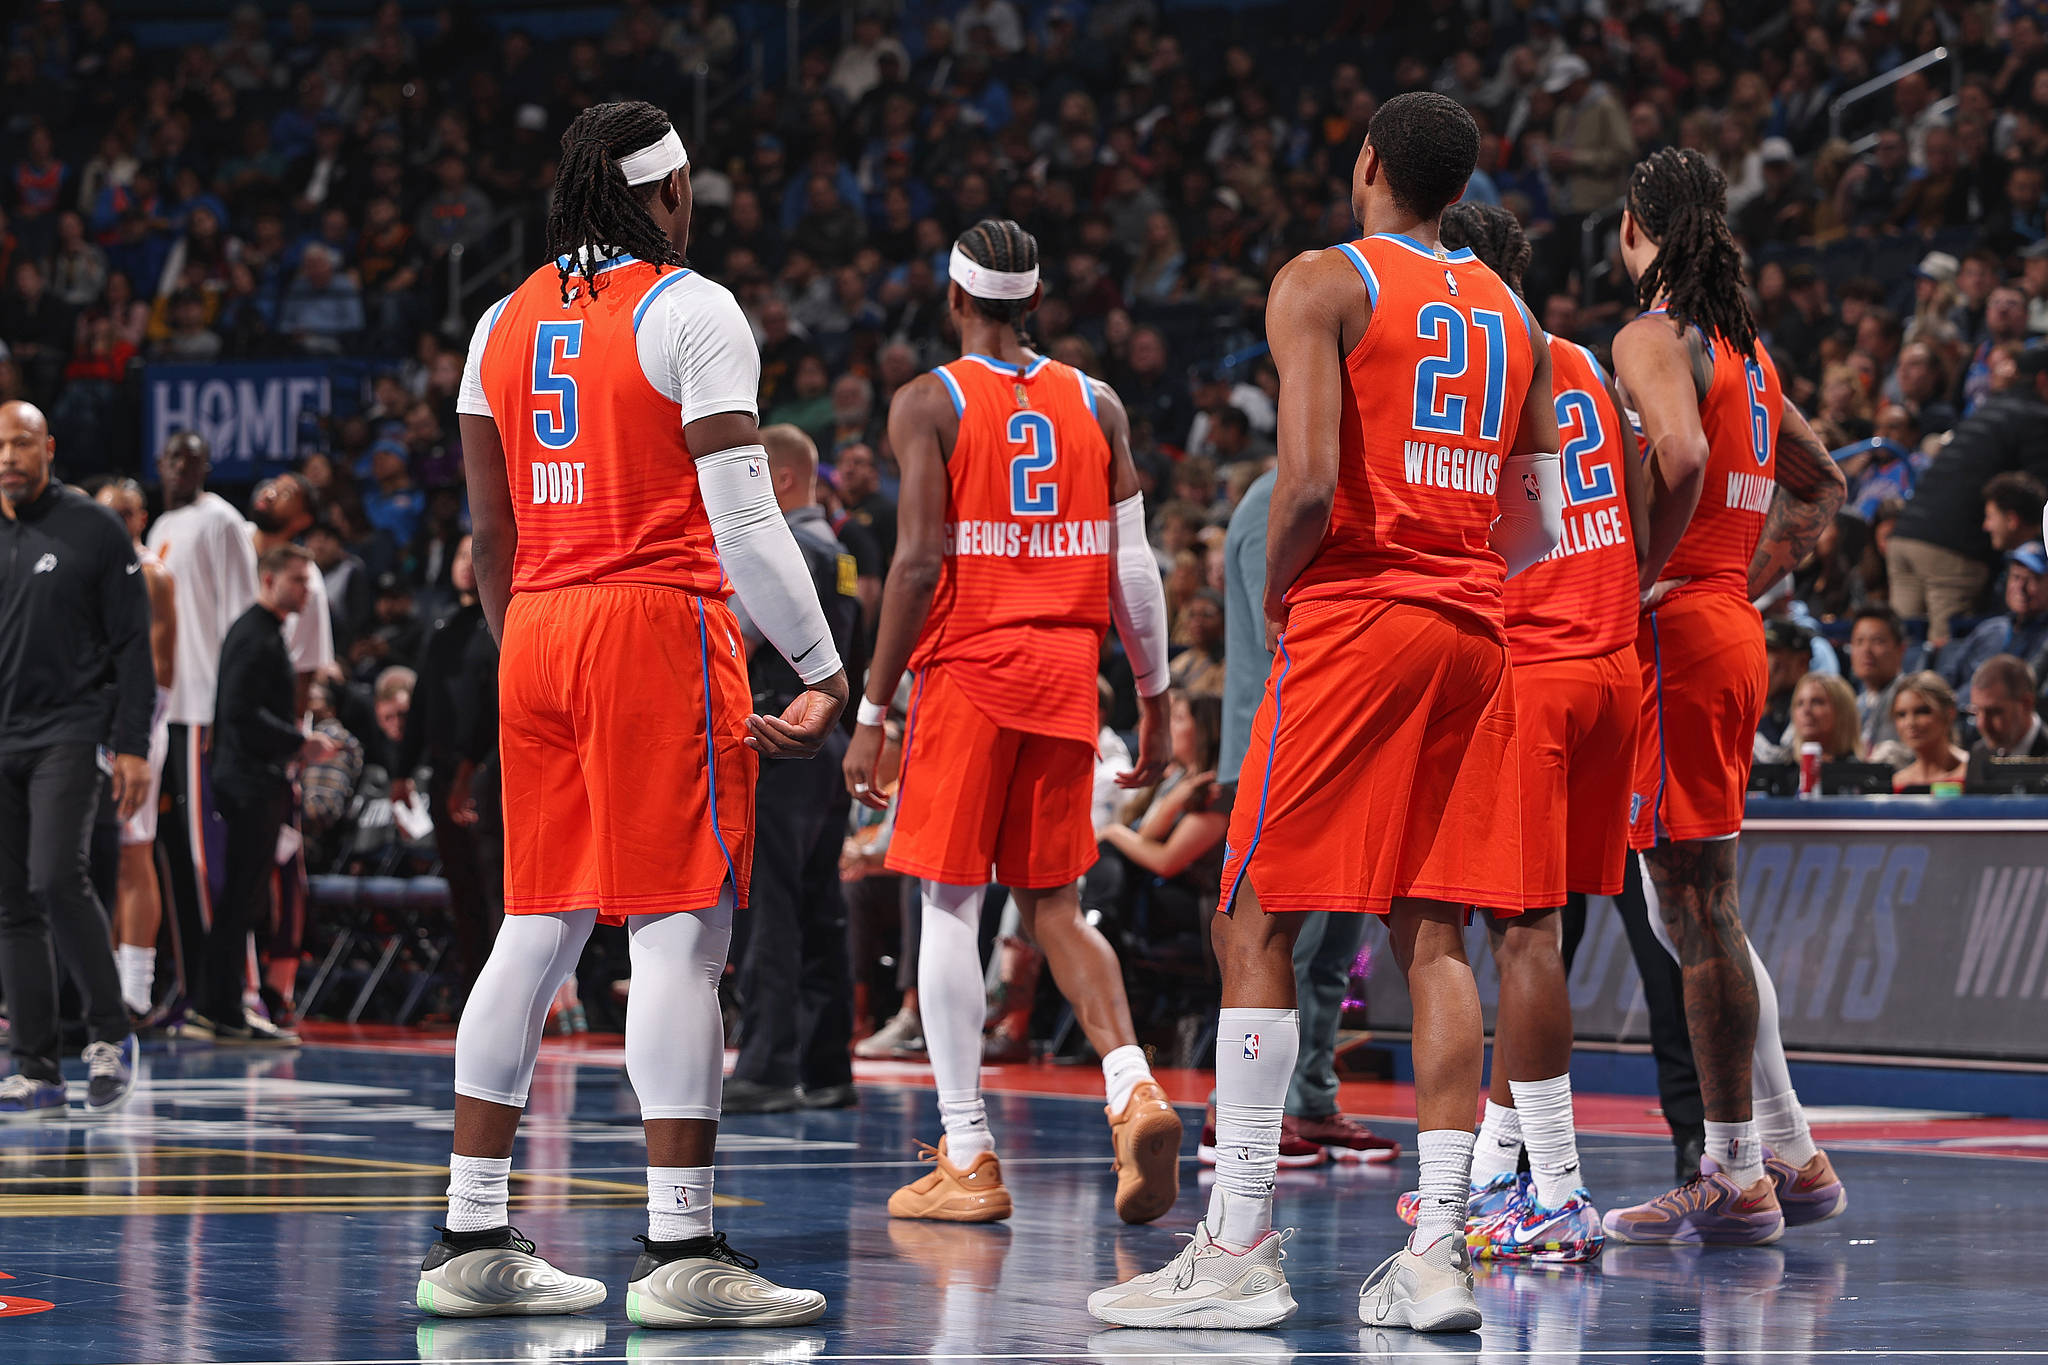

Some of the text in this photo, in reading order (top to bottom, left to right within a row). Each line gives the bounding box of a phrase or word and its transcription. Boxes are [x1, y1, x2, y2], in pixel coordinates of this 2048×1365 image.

[531, 319, 584, 450] 5
[1412, 301, 1507, 442] 21
[1744, 357, 1770, 467] 6
[531, 462, 586, 505] DORT
[1007, 410, 1059, 516] 2
[1403, 440, 1500, 496] WIGGINS
[1538, 506, 1627, 563] ALLACE
